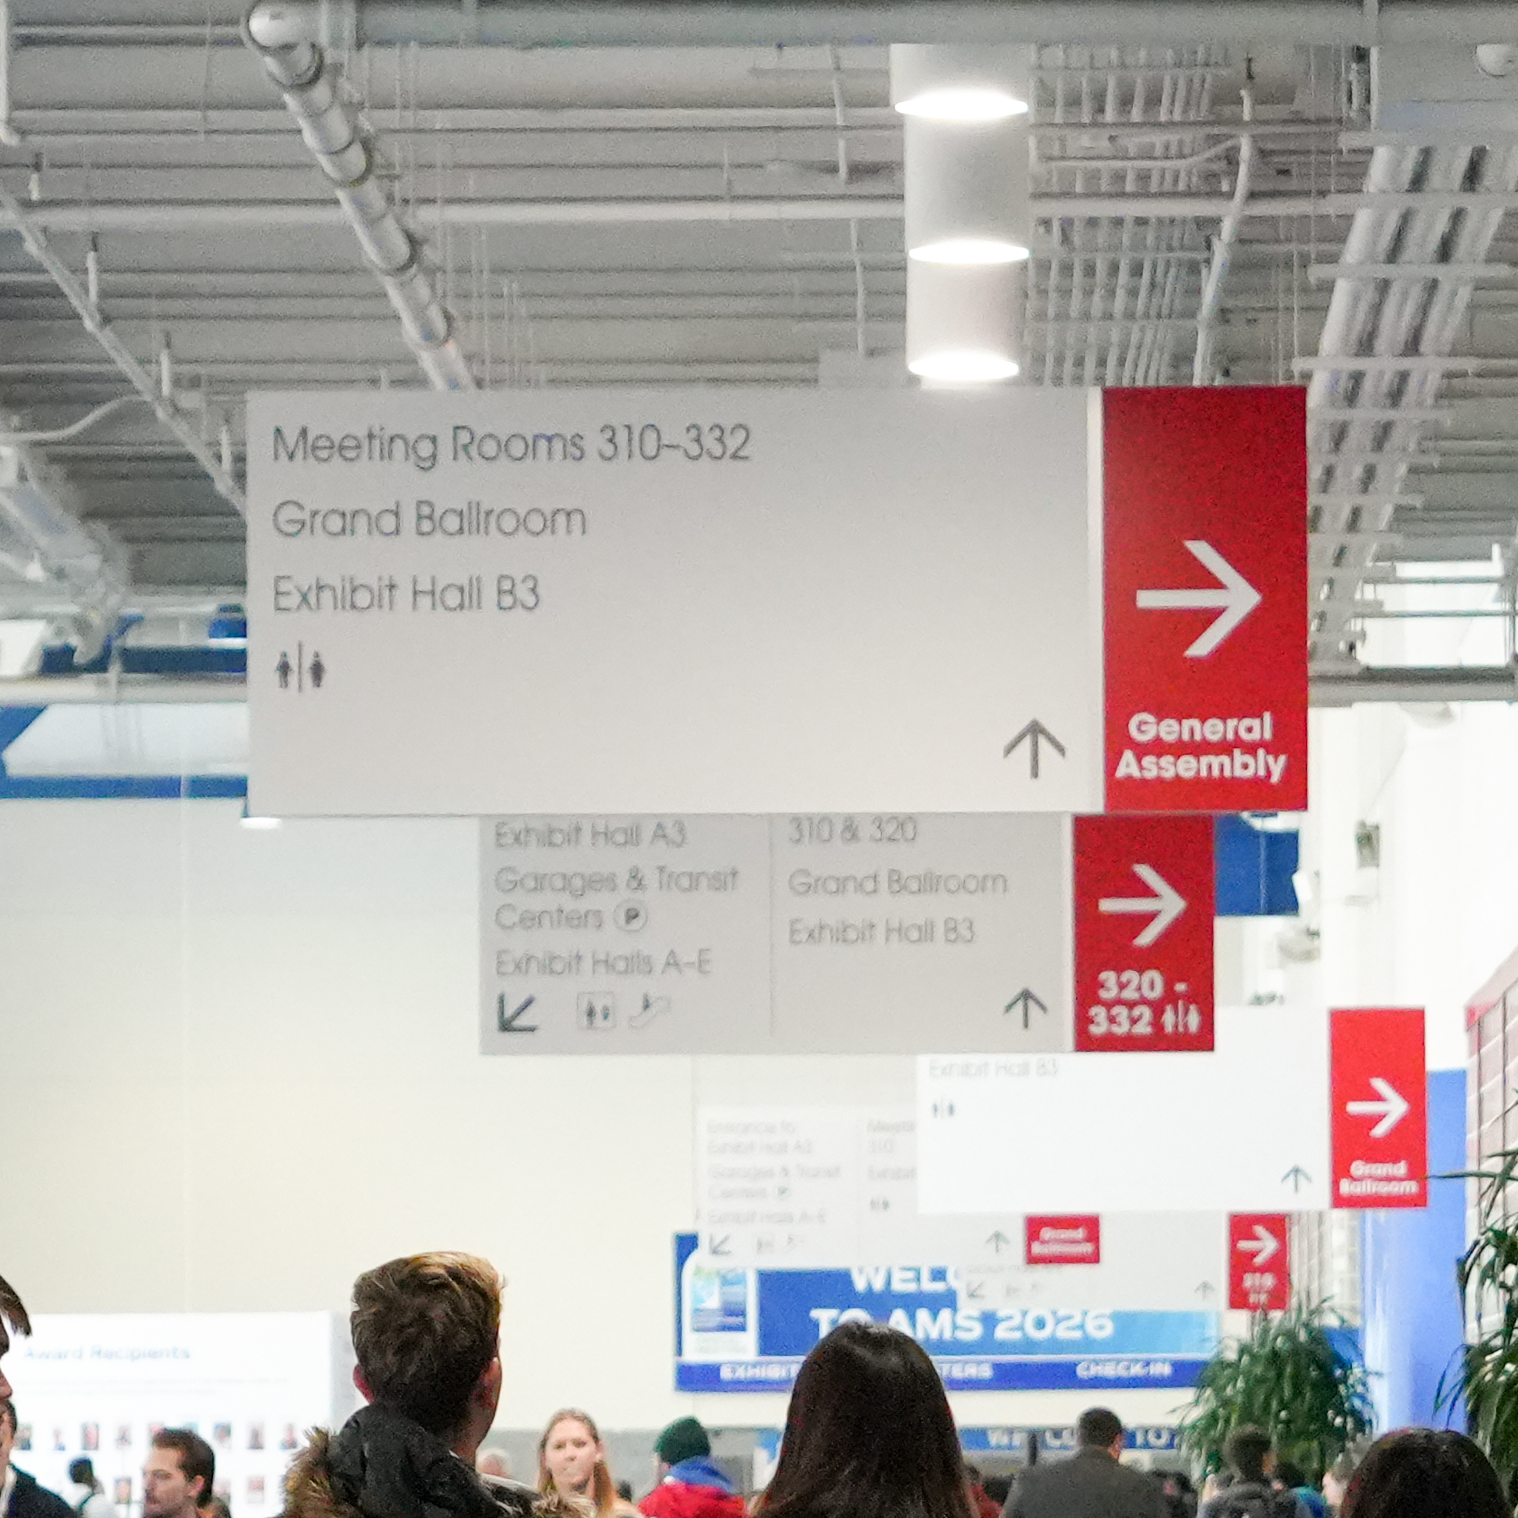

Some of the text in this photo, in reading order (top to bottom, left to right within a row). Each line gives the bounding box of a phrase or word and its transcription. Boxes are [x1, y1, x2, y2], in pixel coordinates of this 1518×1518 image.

[273, 424, 438, 471] Meeting
[452, 424, 586, 464] Rooms
[273, 500, 587, 539] Grand Ballroom
[273, 575, 541, 614] Exhibit Hall B3
[1128, 712, 1272, 743] General
[1115, 748, 1287, 783] Assembly
[495, 820, 688, 848] Exhibit Hall A3
[788, 816, 918, 844] 310 & 320
[495, 866, 739, 898] Garages & Transit
[788, 869, 1008, 895] Grand Ballroom
[495, 903, 603, 929] Centers
[788, 918, 976, 945] Exhibit Hall B3
[495, 948, 712, 976] Exhibit Halls A-E
[1097, 969, 1164, 1000] 320
[1087, 1004, 1154, 1035] 332
[1349, 1160, 1408, 1178] Grand
[1339, 1178, 1419, 1196] Ballroom
[888, 1308, 983, 1340] AMS
[994, 1309, 1115, 1340] 2026
[23, 1345, 192, 1363] Award Recipients
[1075, 1361, 1173, 1379] CHECK-IN
